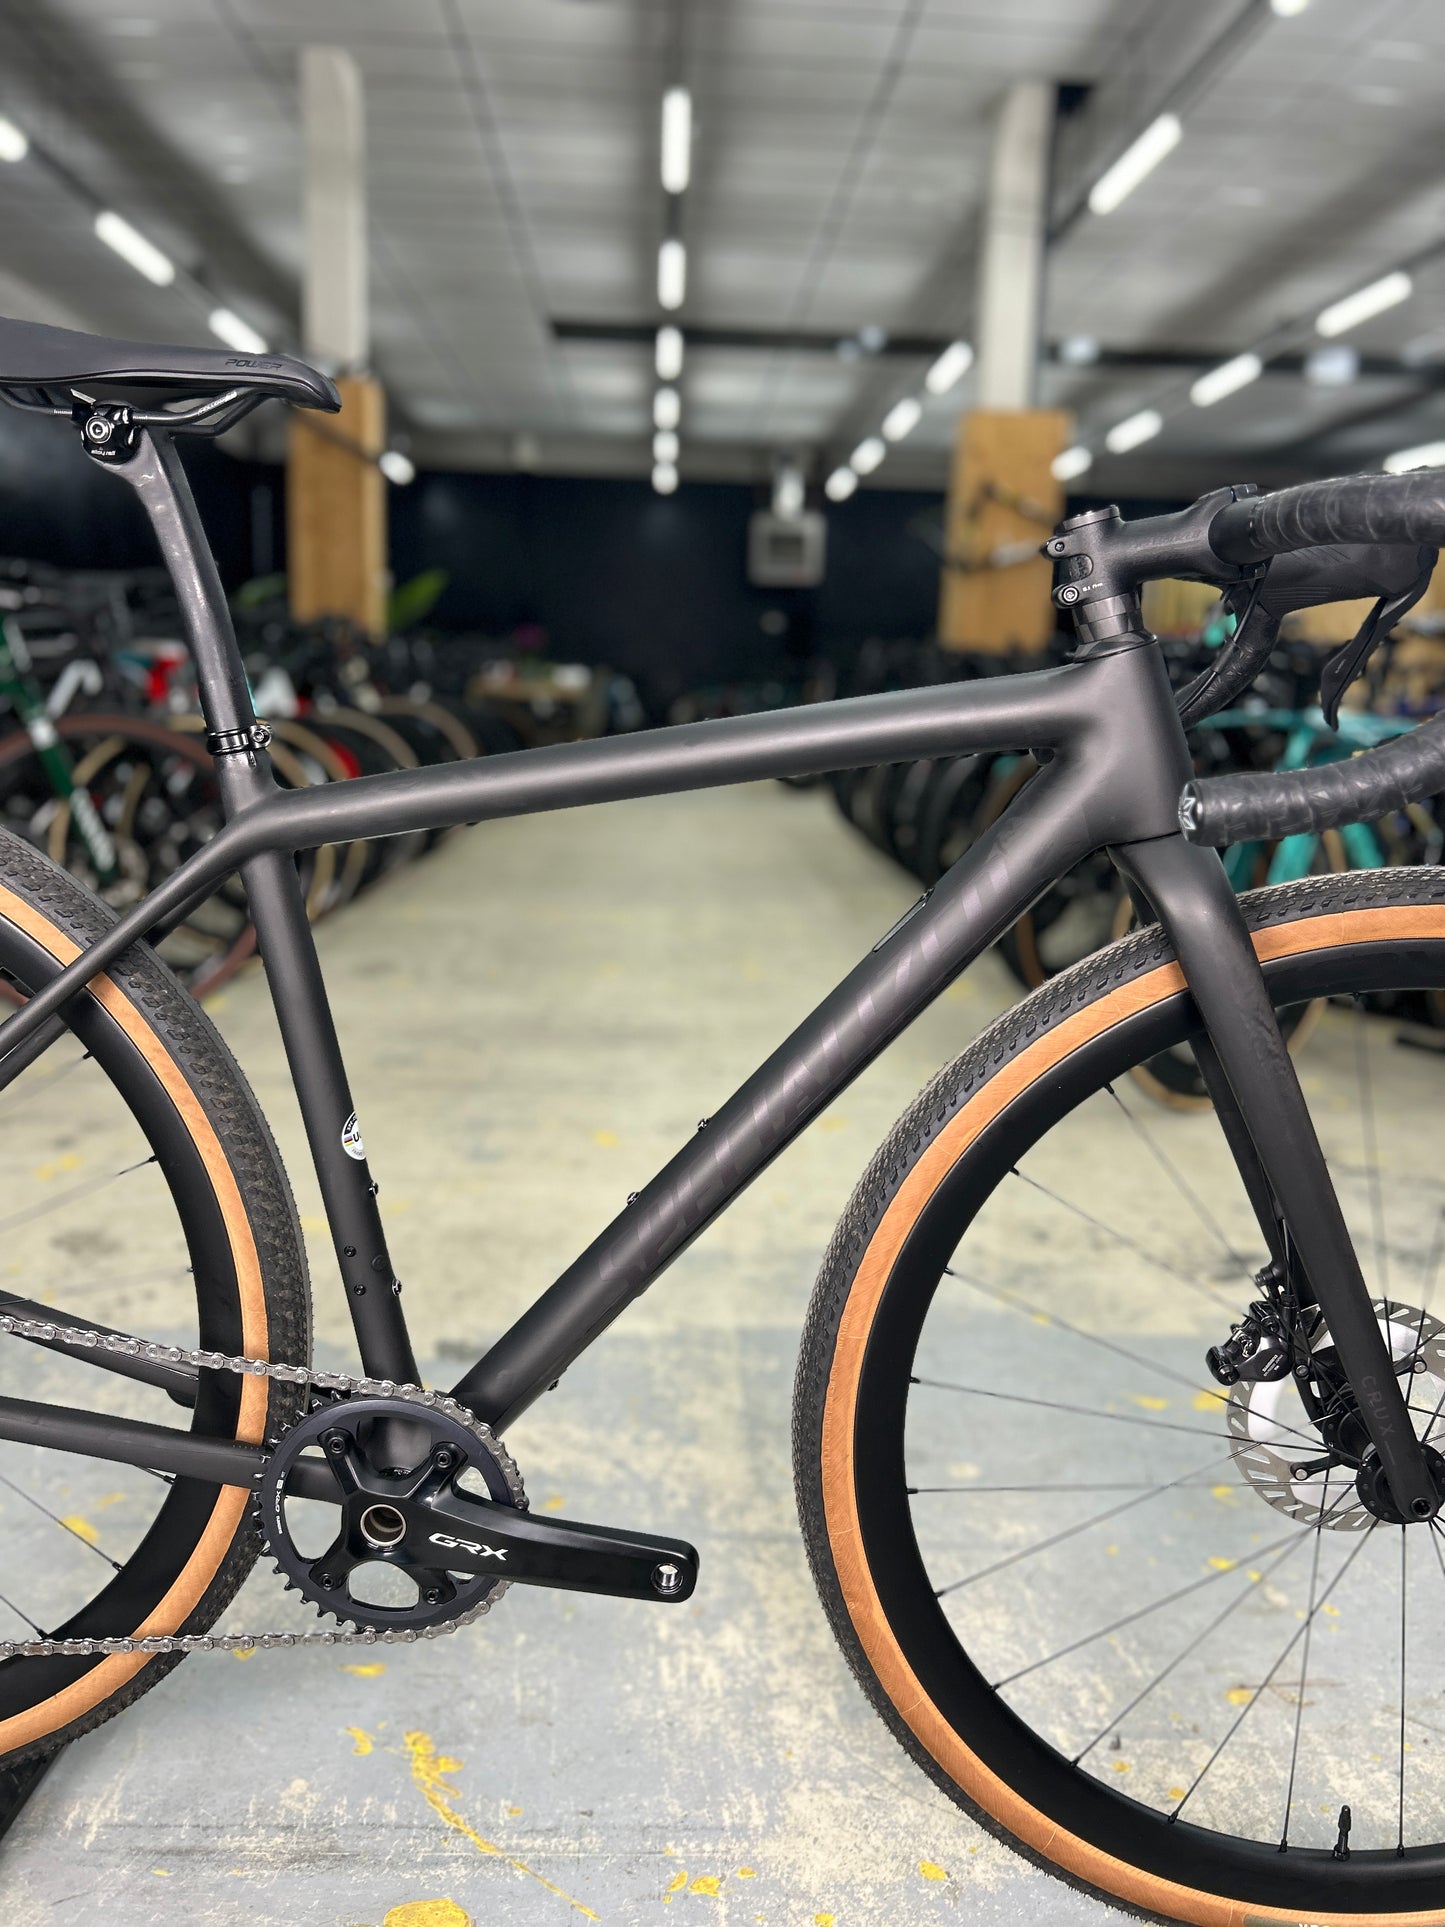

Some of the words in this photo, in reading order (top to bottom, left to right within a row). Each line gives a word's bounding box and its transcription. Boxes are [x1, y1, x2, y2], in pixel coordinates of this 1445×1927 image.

[225, 358, 282, 371] POWER
[601, 849, 1014, 1292] SPECIALIZED
[1361, 1375, 1395, 1437] CRUX
[428, 1532, 509, 1561] GRX
